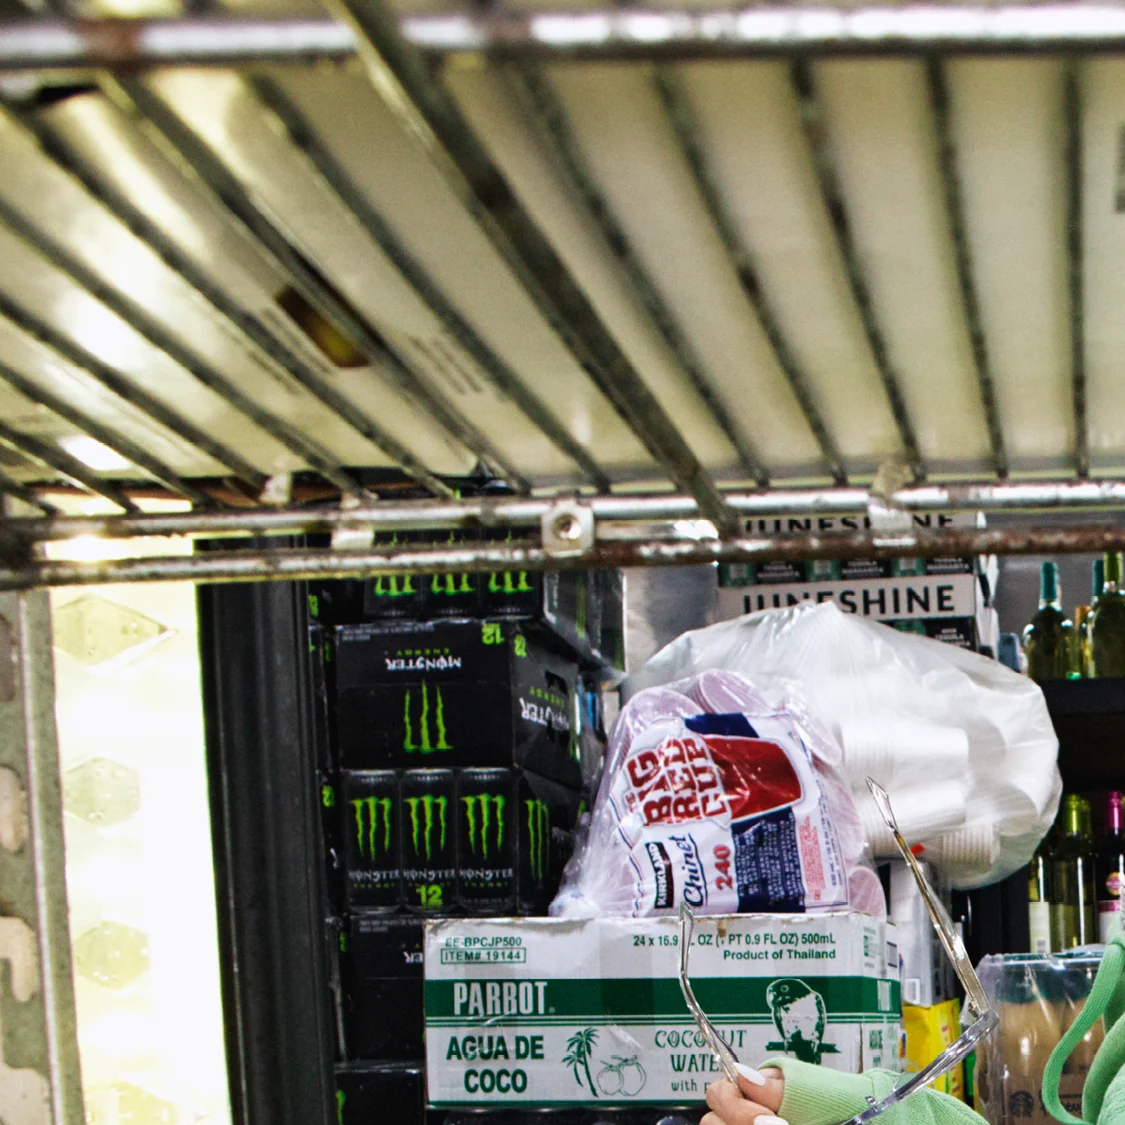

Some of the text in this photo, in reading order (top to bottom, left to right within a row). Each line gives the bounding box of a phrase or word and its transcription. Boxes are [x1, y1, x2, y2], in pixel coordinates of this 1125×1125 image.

[482, 624, 504, 644] 12
[385, 656, 462, 671] MONSTER
[668, 834, 704, 907] Chinet
[713, 845, 734, 890] 240
[416, 884, 444, 905] 12
[633, 935, 645, 946] 24
[658, 935, 679, 946] 16.9
[698, 935, 713, 945] OZ
[728, 935, 743, 945] PT
[745, 935, 760, 945] 0.9
[764, 934, 777, 945] FL
[779, 934, 799, 946] OZ)
[801, 933, 837, 944] 500mL
[445, 950, 521, 961] ITEM# 19144
[723, 949, 836, 960] Product of Thailand
[446, 1036, 544, 1060] AGUA DE
[464, 1069, 528, 1093] COCO
[671, 1079, 698, 1092] with
